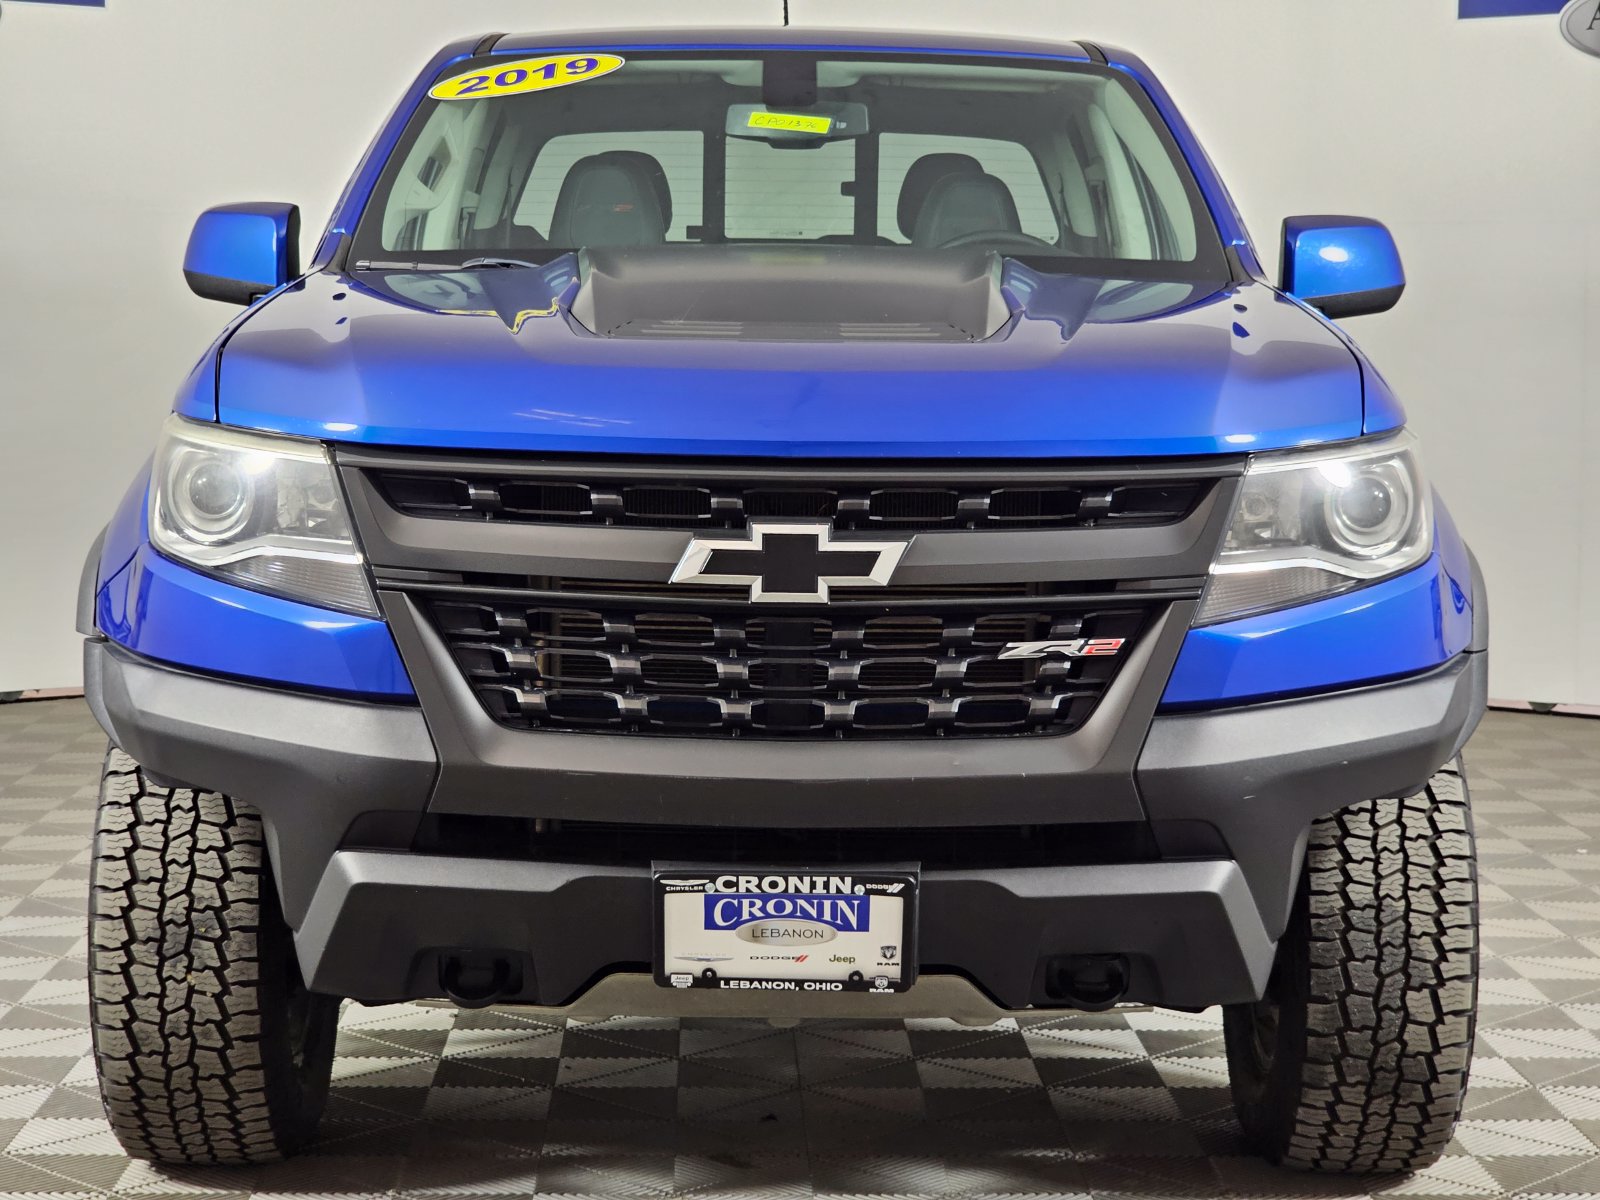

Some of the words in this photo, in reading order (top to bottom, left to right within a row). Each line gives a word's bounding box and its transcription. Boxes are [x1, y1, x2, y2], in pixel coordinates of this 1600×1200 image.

[455, 58, 598, 96] 2019
[998, 638, 1125, 660] ZR2
[715, 875, 852, 895] CRONIN
[713, 898, 861, 930] CRONIN
[751, 928, 824, 939] LEBANON
[829, 954, 856, 965] Jeep
[720, 980, 799, 991] LEBANON,
[803, 982, 843, 991] OHIO
